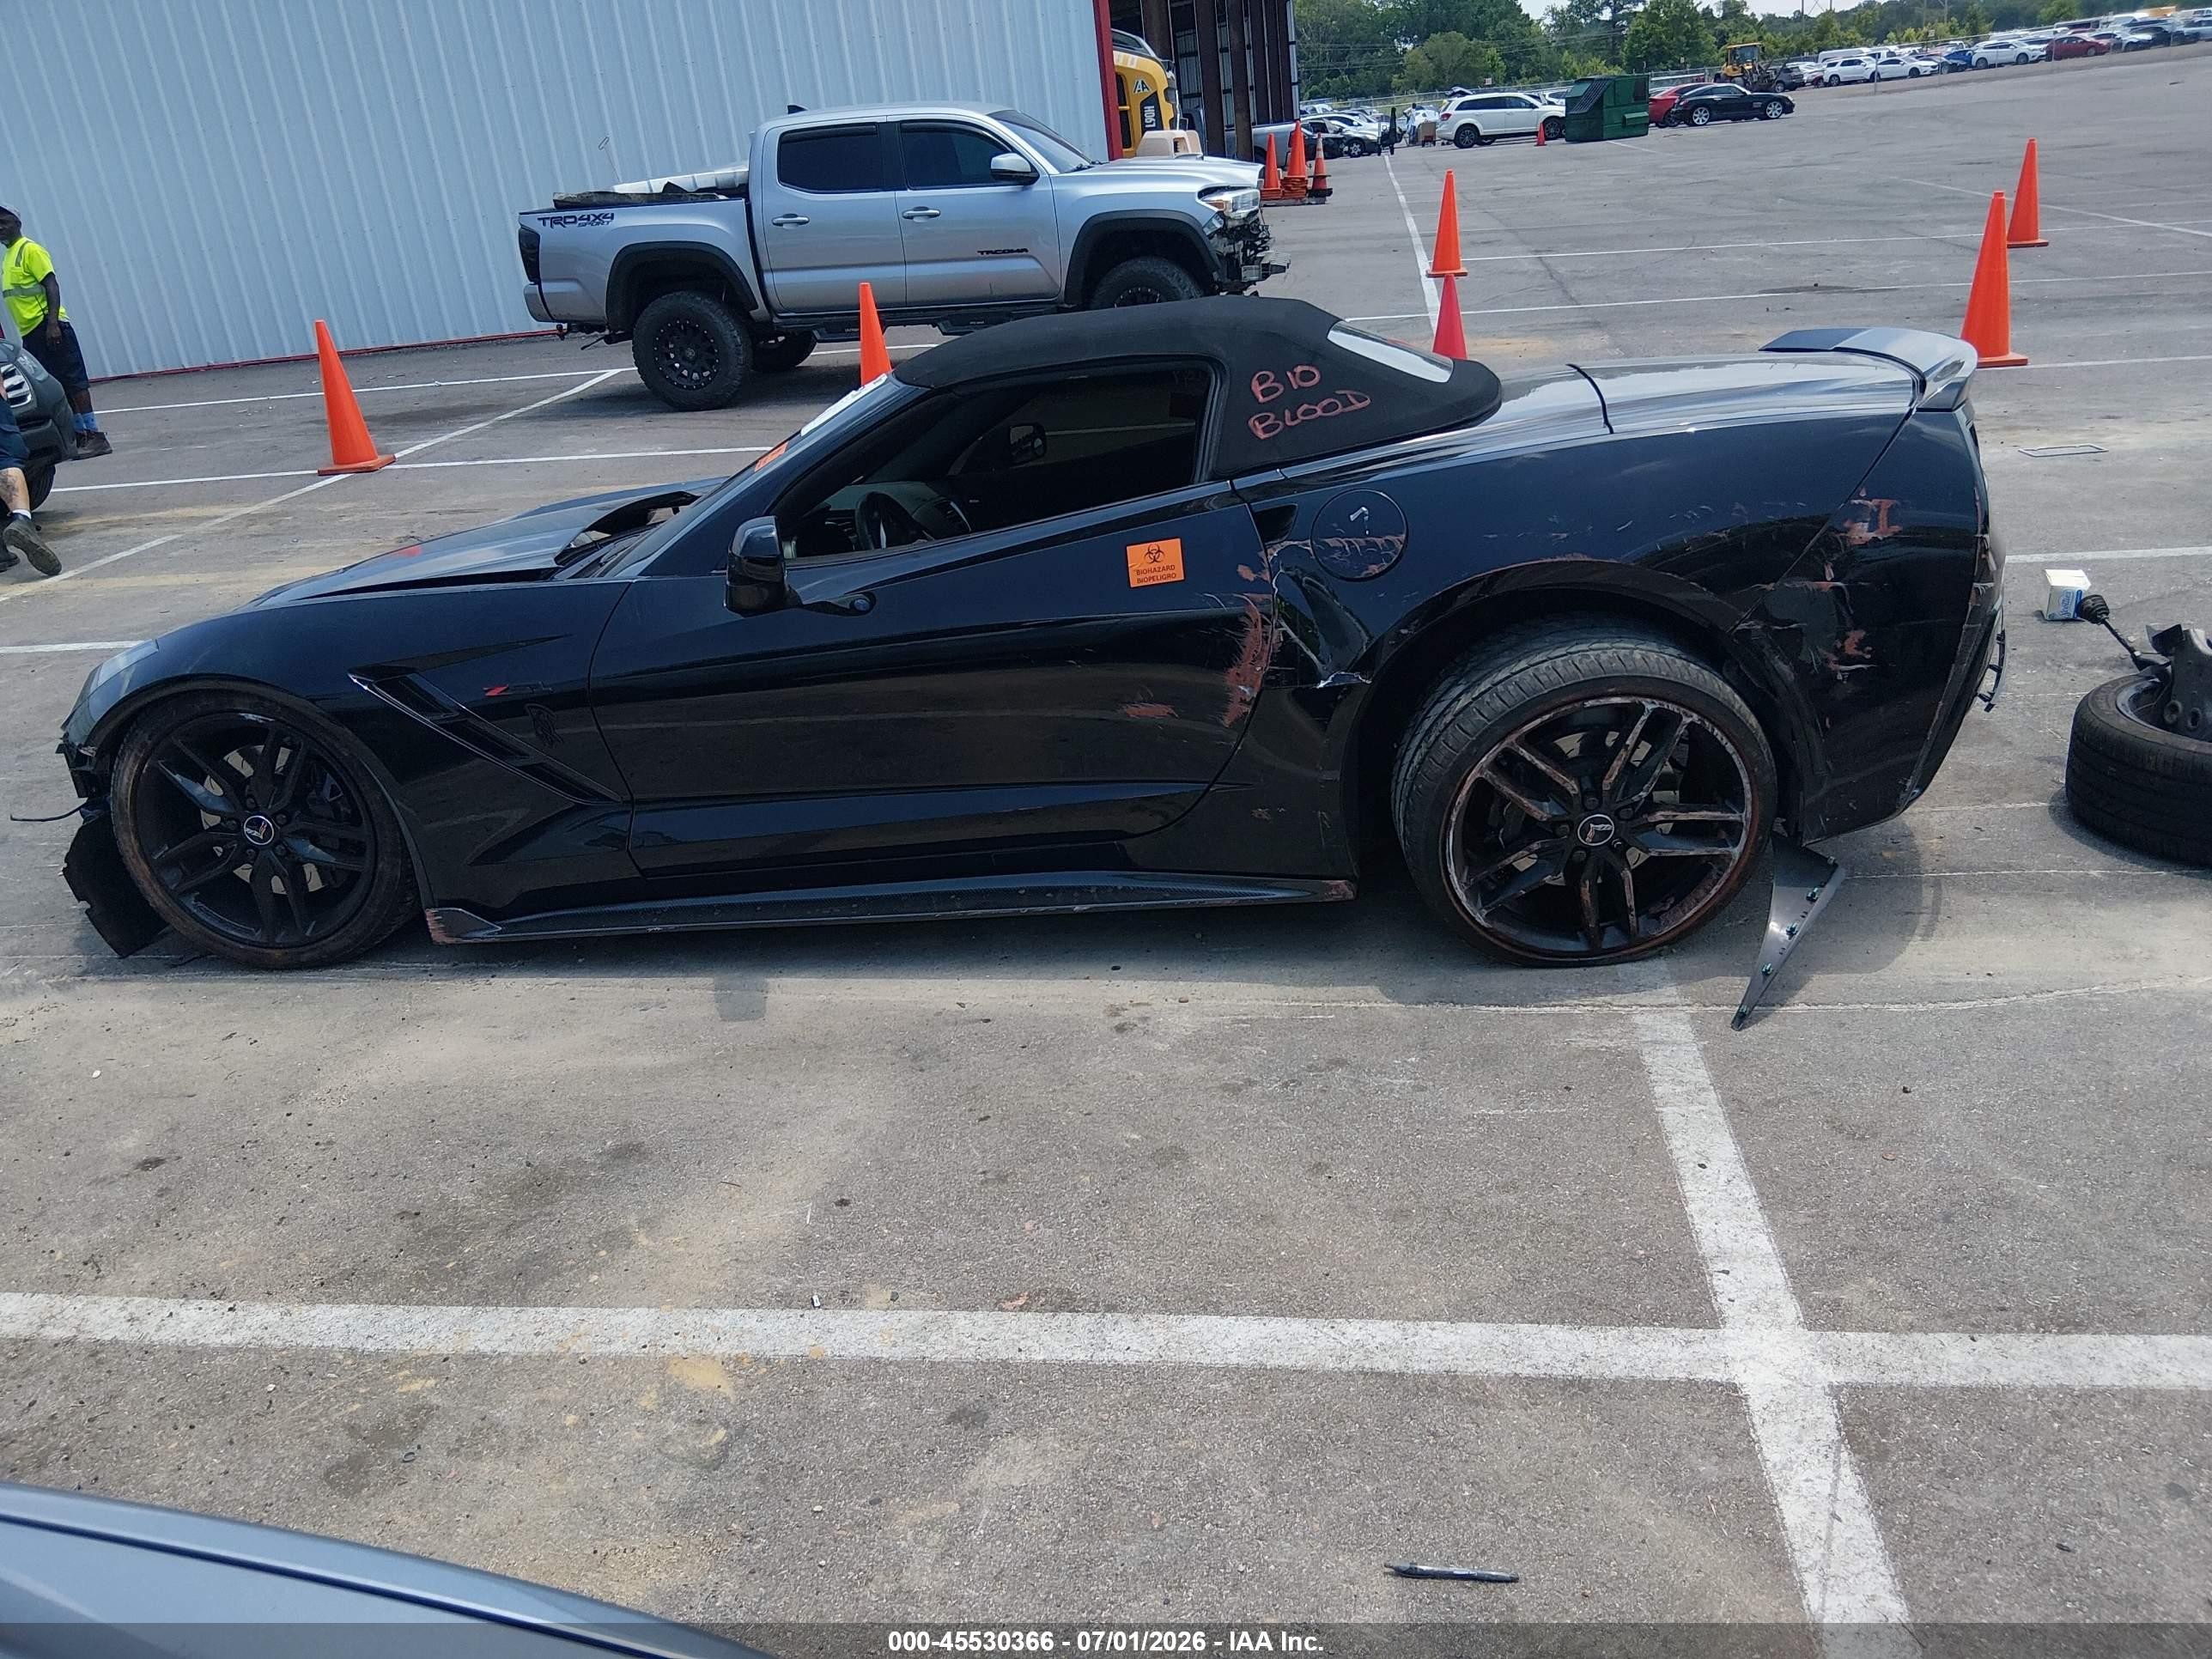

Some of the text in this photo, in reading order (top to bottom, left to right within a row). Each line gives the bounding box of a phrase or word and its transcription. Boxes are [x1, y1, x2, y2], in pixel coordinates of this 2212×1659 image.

[1144, 105, 1156, 128] L90H
[1248, 389, 1372, 441] BLOOD
[1136, 564, 1176, 576] BIOHAZARD
[1136, 573, 1176, 584] BIOPELIGRO
